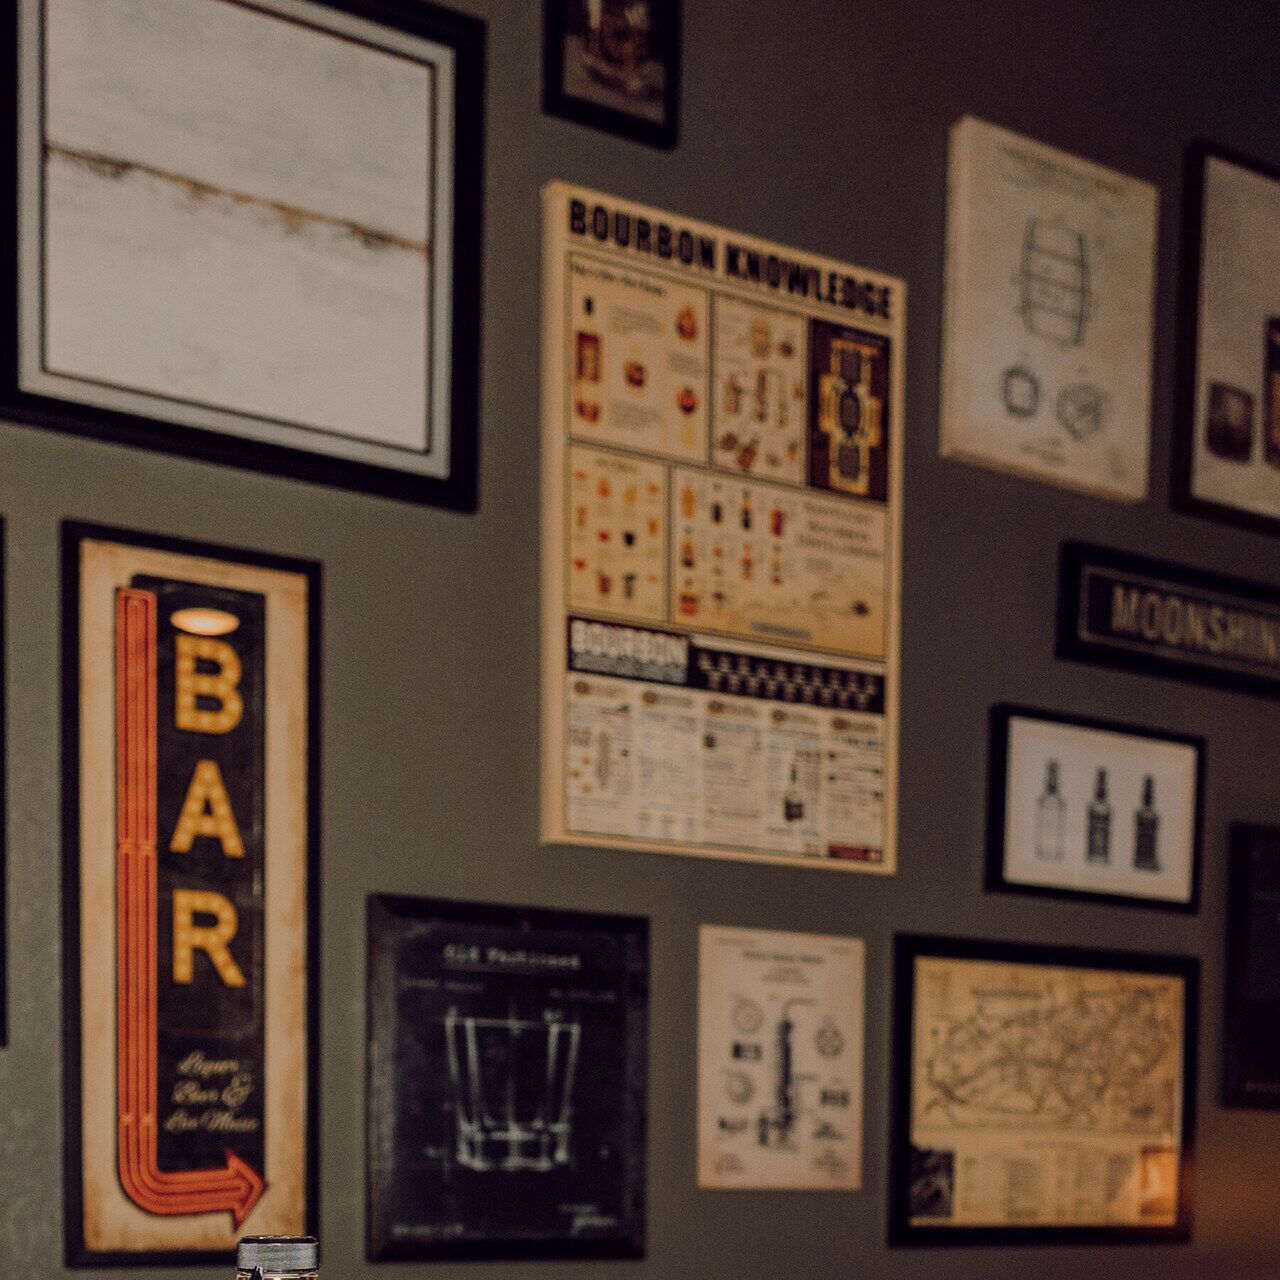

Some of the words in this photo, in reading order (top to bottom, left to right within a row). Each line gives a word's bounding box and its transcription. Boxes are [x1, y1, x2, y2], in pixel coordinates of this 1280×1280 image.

[569, 198, 716, 271] BOURBON
[724, 242, 892, 319] KNOWLEDGE
[169, 633, 246, 988] BAR
